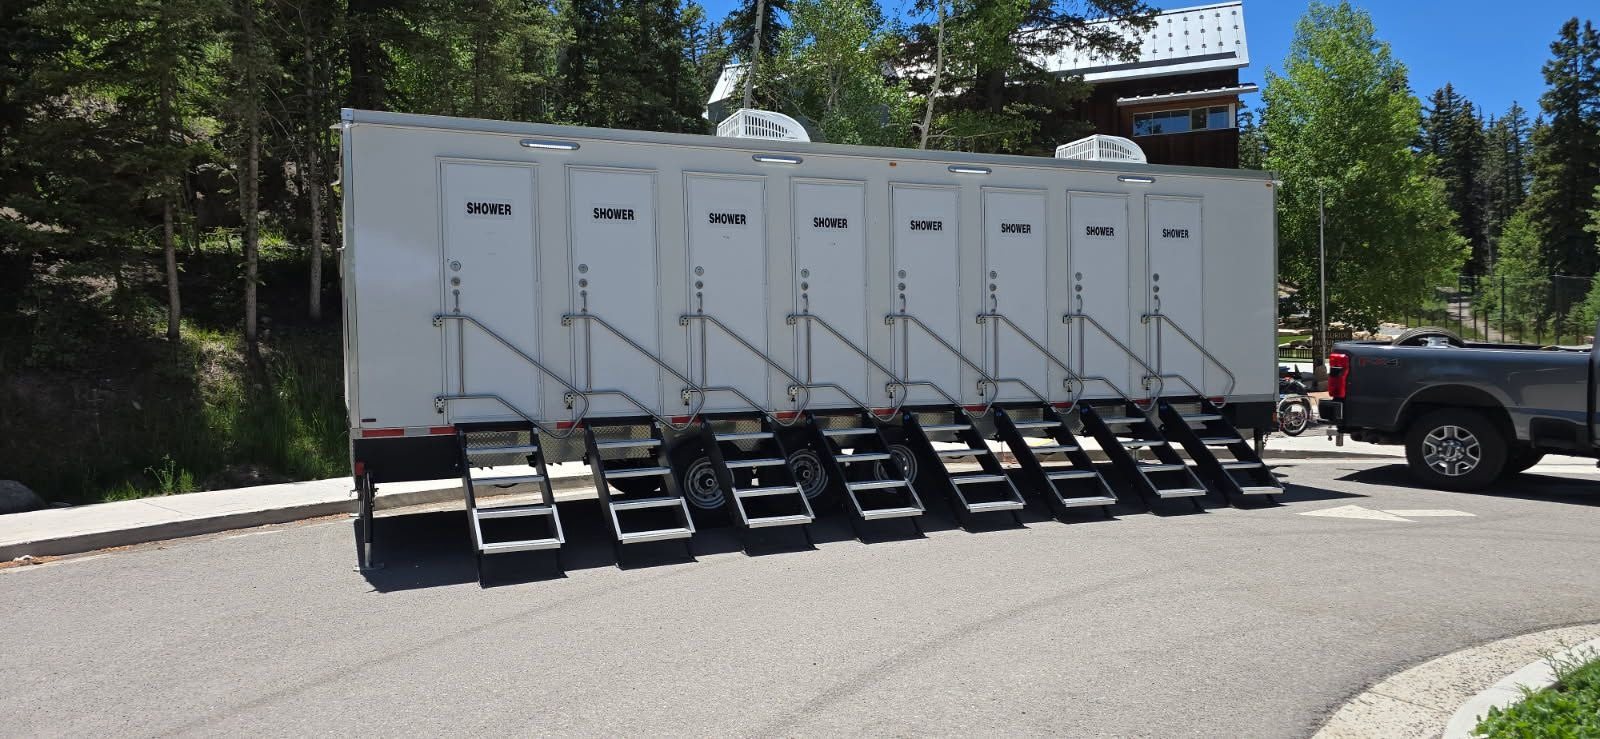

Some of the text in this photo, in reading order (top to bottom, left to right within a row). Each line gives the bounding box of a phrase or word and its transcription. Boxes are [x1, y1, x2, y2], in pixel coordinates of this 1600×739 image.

[467, 202, 512, 215] SHOWER
[593, 207, 635, 221] SHOWER
[708, 213, 746, 224] SHOWER
[813, 217, 848, 228] SHOWER
[910, 220, 942, 231] SHOWER
[1001, 223, 1031, 234] SHOWER
[1086, 226, 1115, 237] SHOWER
[1162, 229, 1189, 239] SHOWER
